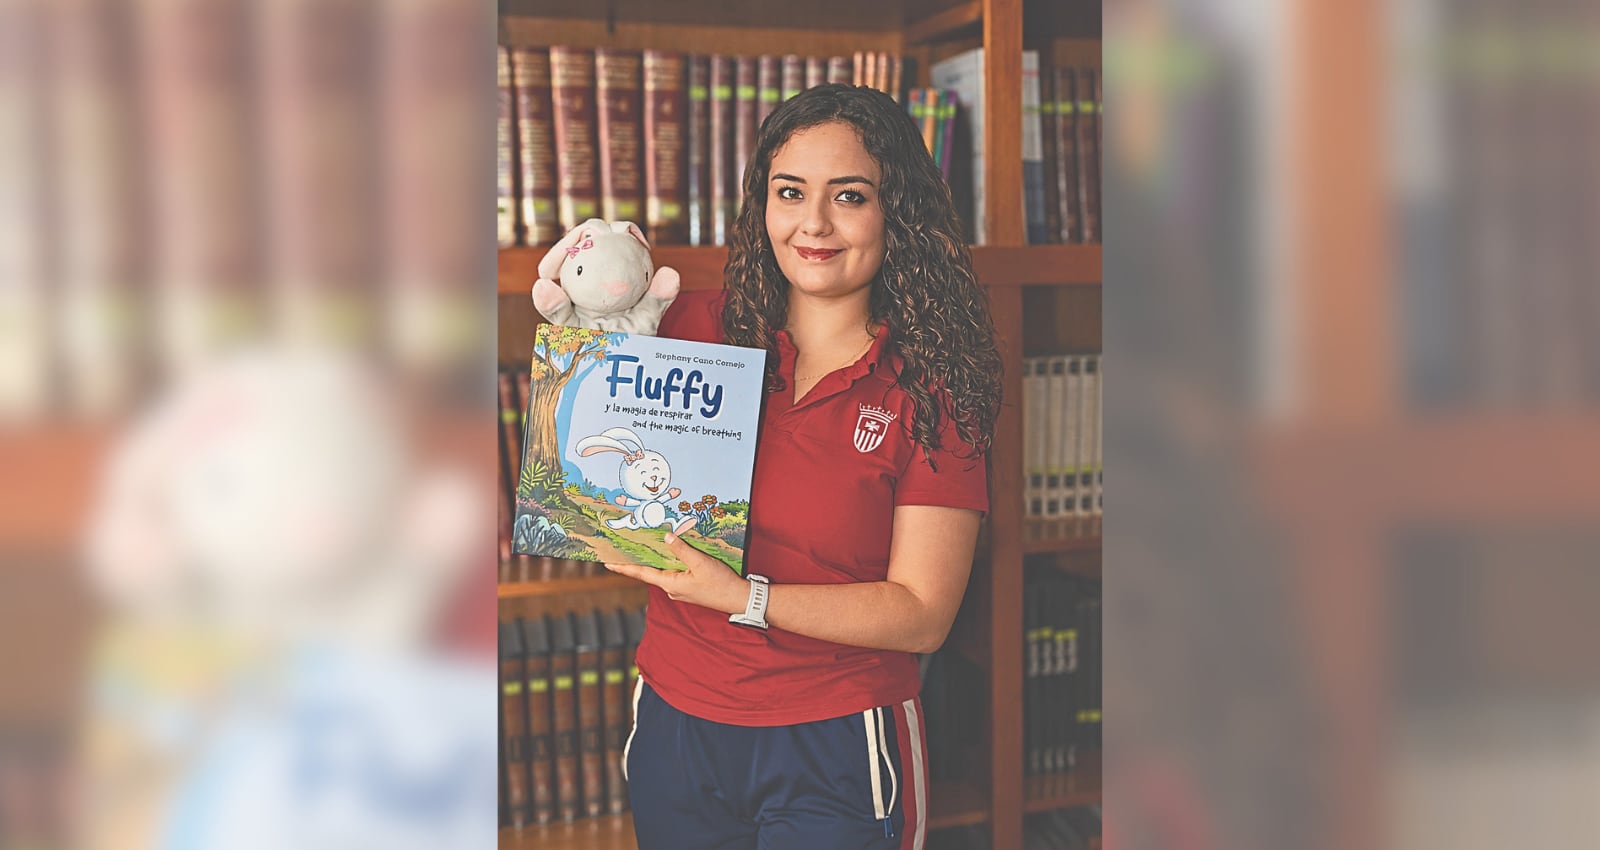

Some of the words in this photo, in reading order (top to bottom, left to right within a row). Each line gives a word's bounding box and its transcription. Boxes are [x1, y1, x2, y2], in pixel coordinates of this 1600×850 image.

[655, 352, 692, 363] Stephany
[693, 357, 714, 365] Cano
[715, 359, 745, 369] Cornejo
[606, 354, 724, 419] Fluffy
[604, 404, 611, 413] y
[613, 403, 620, 413] la
[622, 406, 646, 416] magia
[649, 408, 658, 416] de
[660, 411, 693, 420] respirar
[632, 420, 647, 429] and
[649, 422, 663, 431] the
[665, 424, 689, 435] magic
[692, 425, 700, 433] of
[702, 427, 741, 441] breathing
